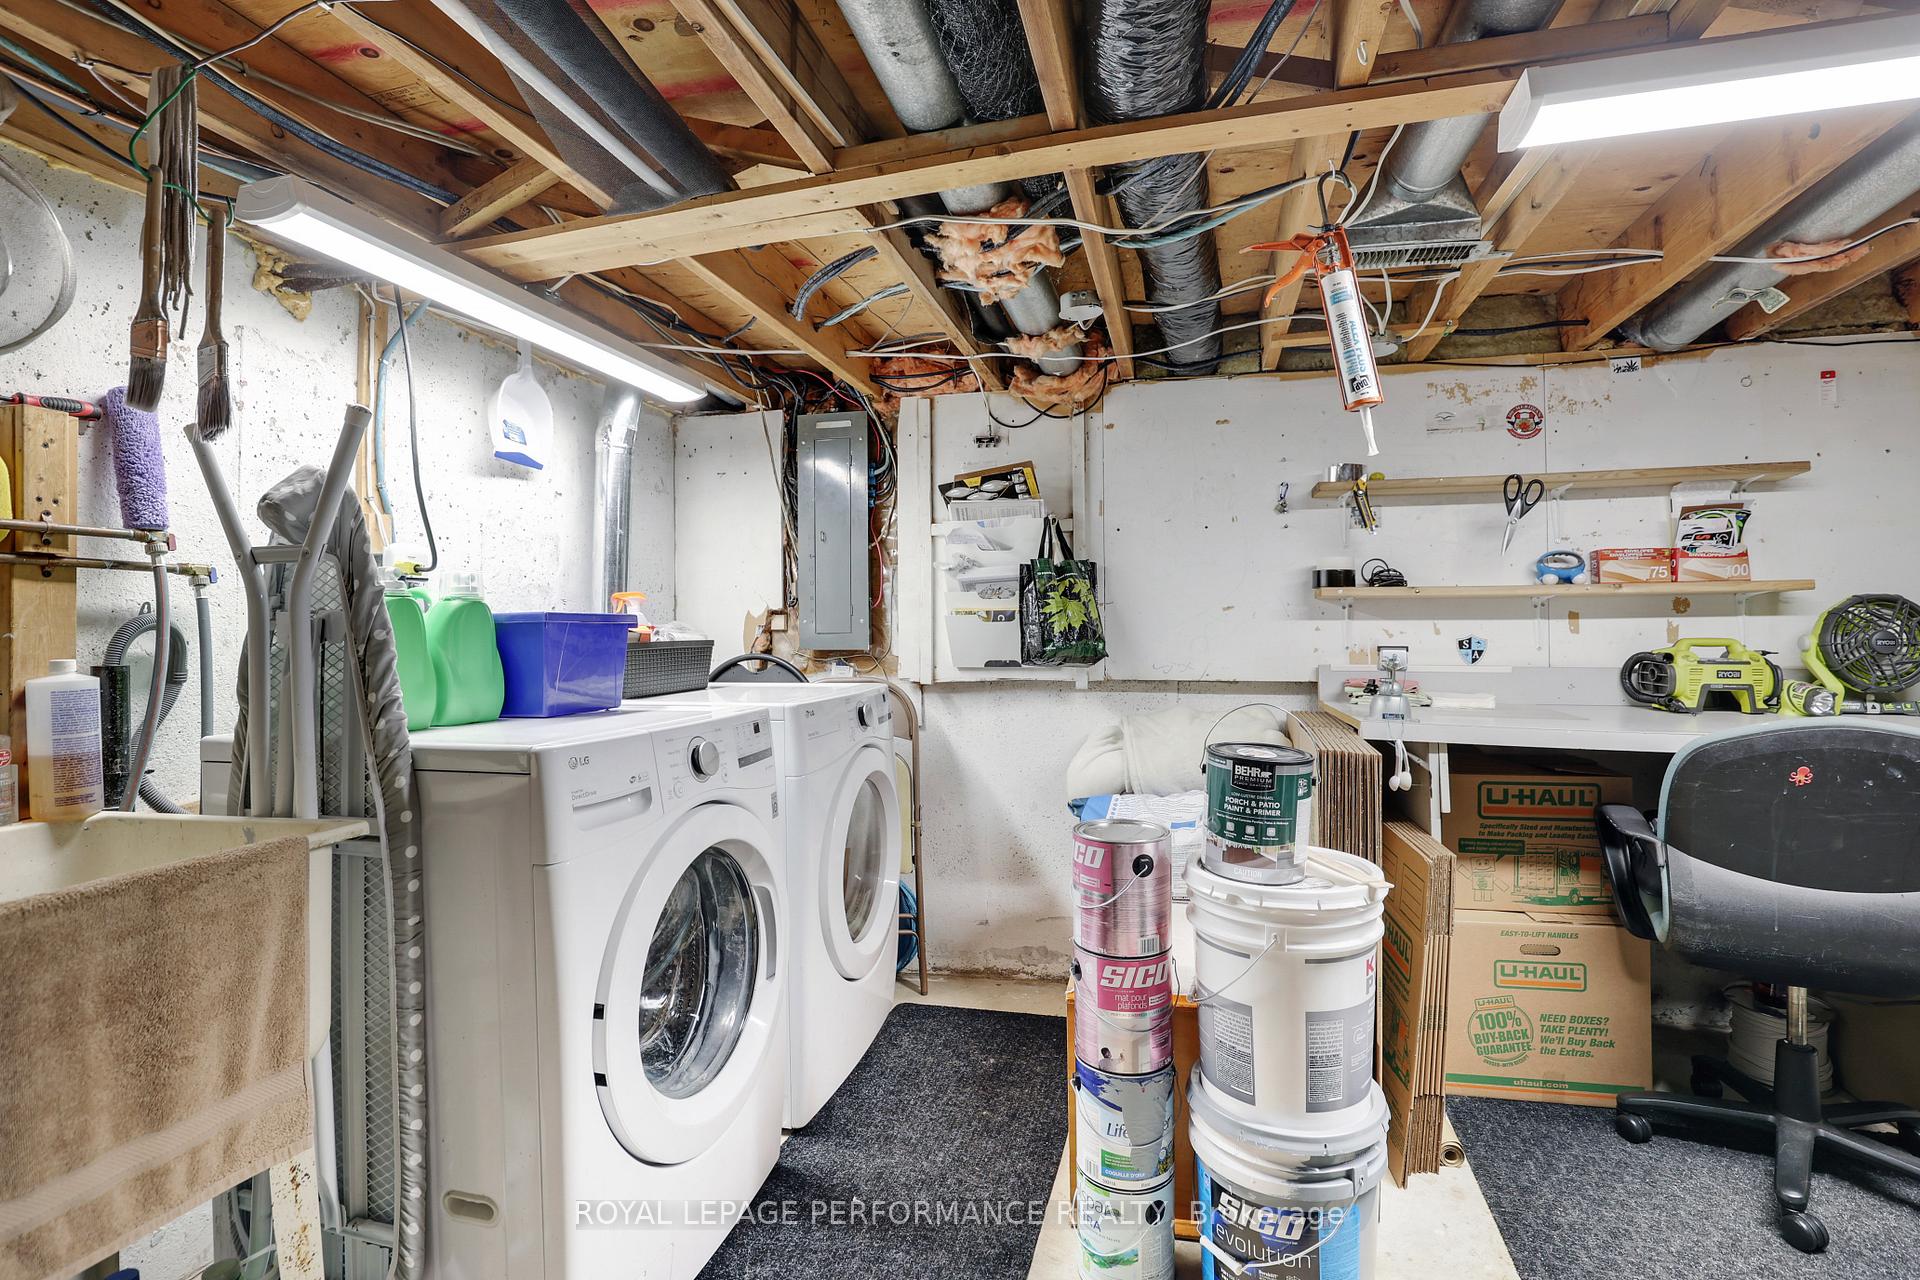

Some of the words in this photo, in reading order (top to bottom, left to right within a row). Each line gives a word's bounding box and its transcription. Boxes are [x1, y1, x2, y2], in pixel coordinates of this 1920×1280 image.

[1355, 378, 1369, 392] DAP
[1649, 565, 1667, 578] 75
[1462, 640, 1469, 649] S
[1472, 651, 1480, 659] A
[1234, 764, 1261, 778] BEHR
[1234, 775, 1272, 783] PREMIUM
[1225, 796, 1249, 806] PORCH
[1250, 799, 1257, 807] &
[1258, 801, 1280, 809] PATIO
[1486, 788, 1593, 807] U-HAUL
[1223, 803, 1244, 814] PAINT
[1253, 808, 1281, 816] PRIMER
[1479, 822, 1518, 831] Specifically
[1506, 831, 1532, 839] Packing
[1549, 832, 1575, 840] Loading
[1234, 867, 1262, 879] CAUTION
[1500, 930, 1546, 938] EASY-TO-LIFT
[1547, 931, 1579, 940] HANDLES
[1100, 960, 1170, 989] SICO
[1500, 964, 1581, 981] U-HAUL
[1131, 994, 1147, 1003] pour
[1477, 997, 1513, 1007] U-HAUL
[1117, 1001, 1148, 1011] plafonds
[1475, 1010, 1522, 1031] 100%
[1539, 1014, 1566, 1023] NEED
[1569, 1016, 1610, 1026] BOXES?
[1473, 1028, 1530, 1045] BUY-BACK
[1540, 1025, 1564, 1034] TAKE
[1568, 1027, 1609, 1037] PLENTY!
[1540, 1036, 1565, 1046] We'll
[1567, 1037, 1586, 1048] Buy
[1589, 1039, 1616, 1049] Back
[1476, 1042, 1532, 1056] GUARANTEE
[1540, 1046, 1556, 1055] the
[1559, 1048, 1594, 1058] Extras.
[1513, 1080, 1569, 1089] uhaul.com
[1216, 1223, 1311, 1269] evolution
